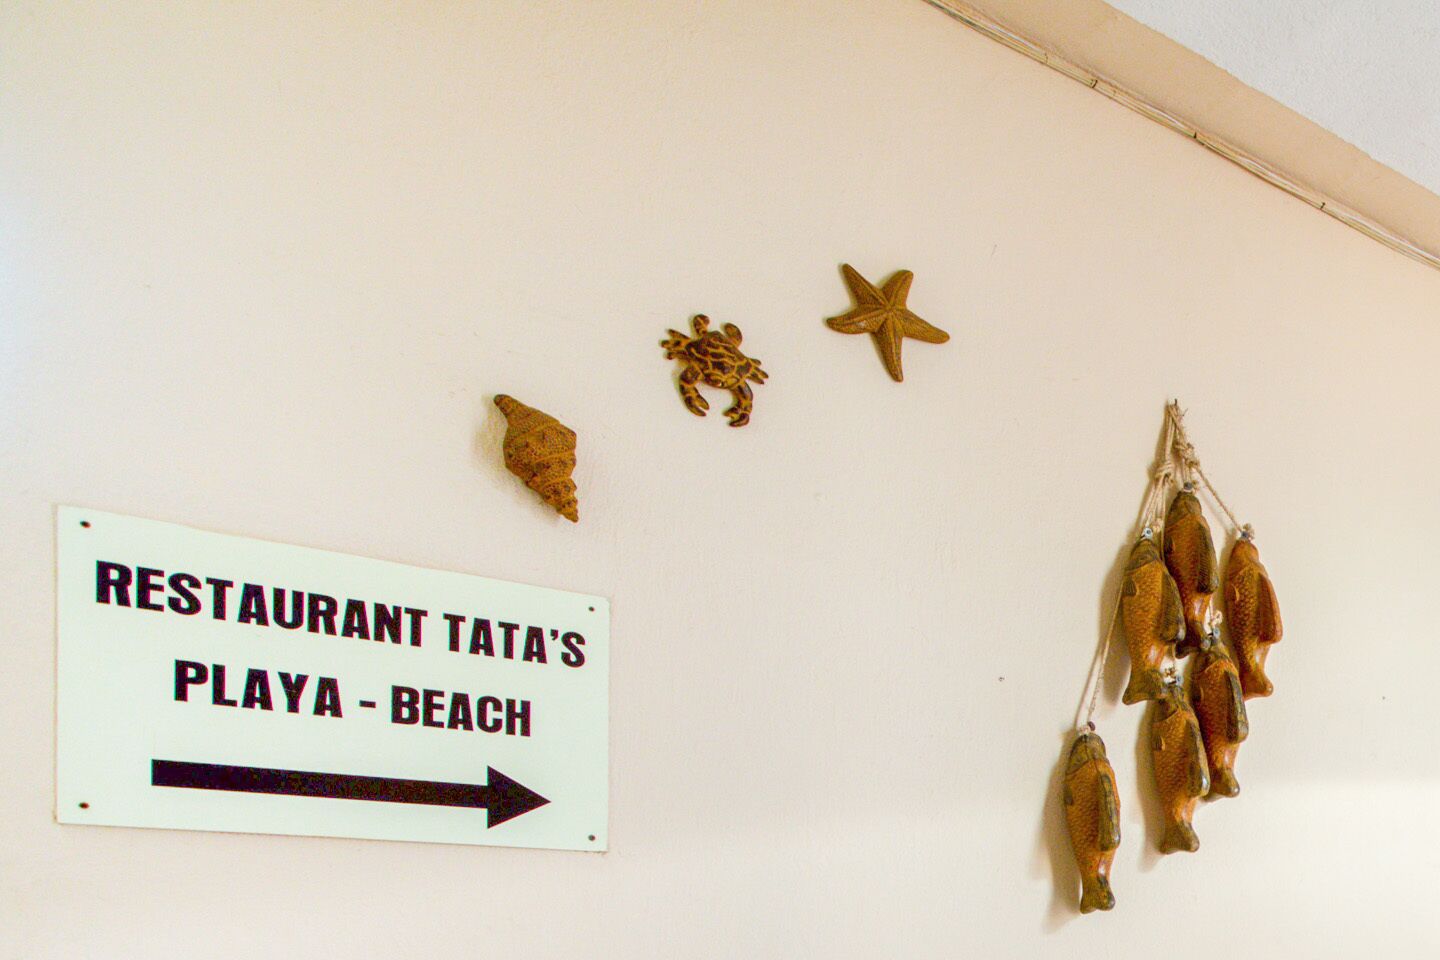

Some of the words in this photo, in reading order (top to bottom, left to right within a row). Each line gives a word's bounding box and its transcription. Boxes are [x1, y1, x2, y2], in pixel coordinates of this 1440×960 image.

[95, 560, 428, 647] RESTAURANT
[443, 612, 587, 669] TATA'S
[173, 659, 343, 719] PLAYA
[359, 699, 377, 709] -
[391, 684, 531, 737] BEACH
